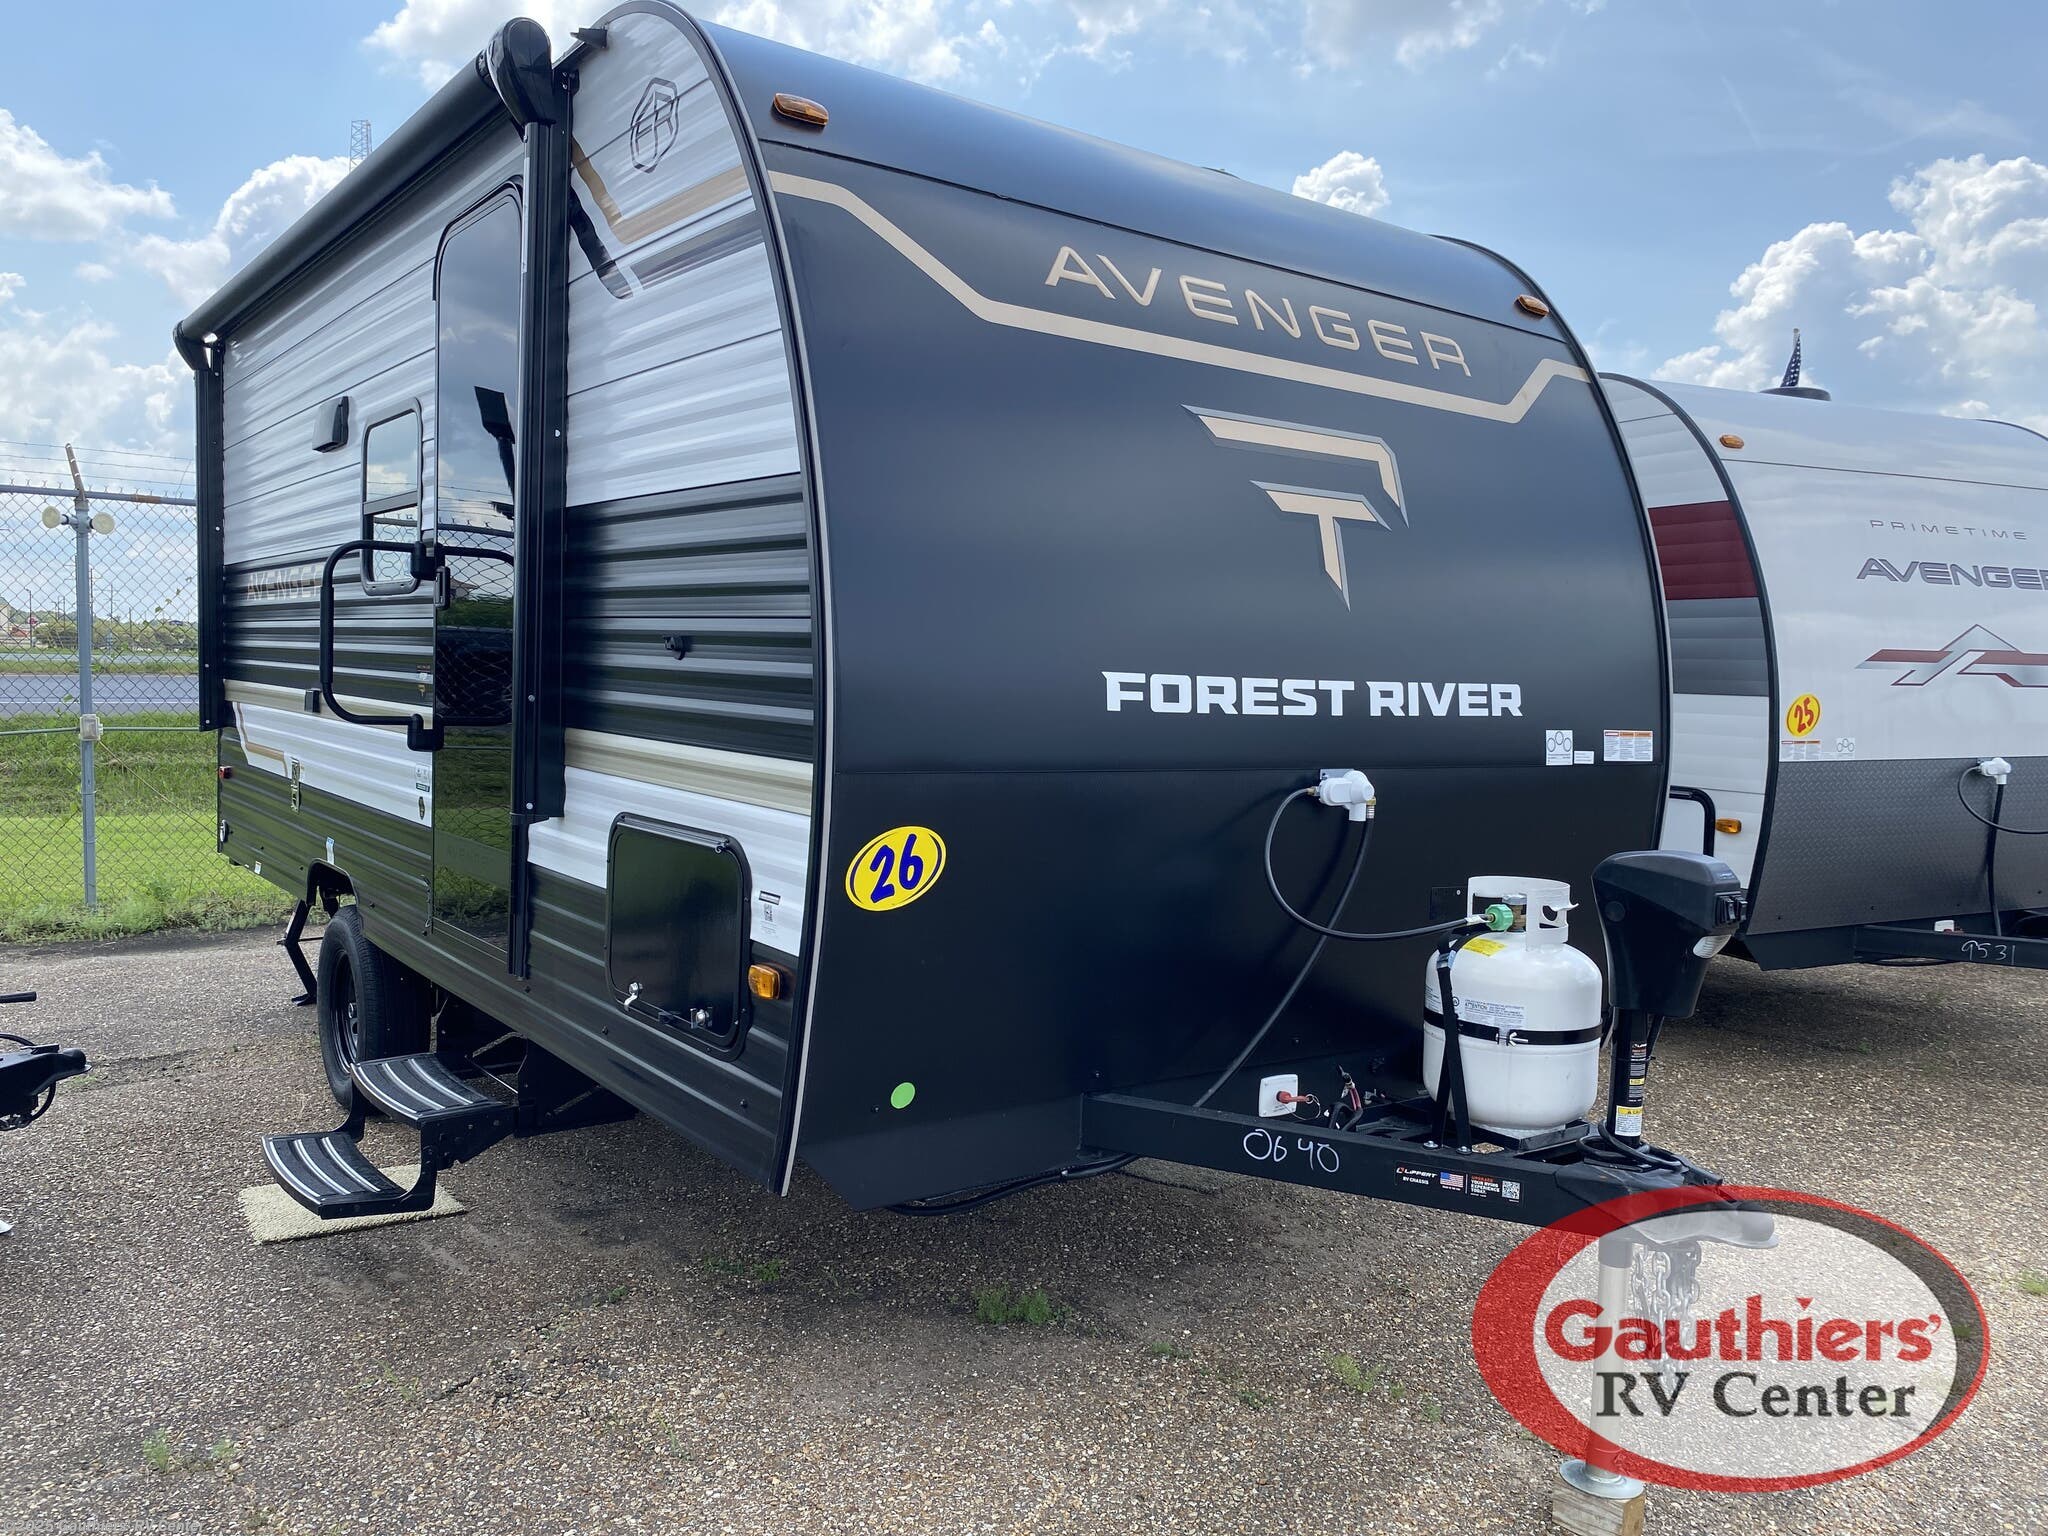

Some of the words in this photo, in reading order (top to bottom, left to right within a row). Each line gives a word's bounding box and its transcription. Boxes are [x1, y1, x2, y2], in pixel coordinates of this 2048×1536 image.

[1045, 246, 1472, 377] AVENGER
[1870, 519, 2027, 540] PRIMETIME
[1102, 671, 1355, 716] FOREST
[1366, 681, 1523, 717] RIVER
[1794, 696, 1815, 734] 25
[869, 833, 924, 903] 26
[1961, 940, 2016, 966] 9531
